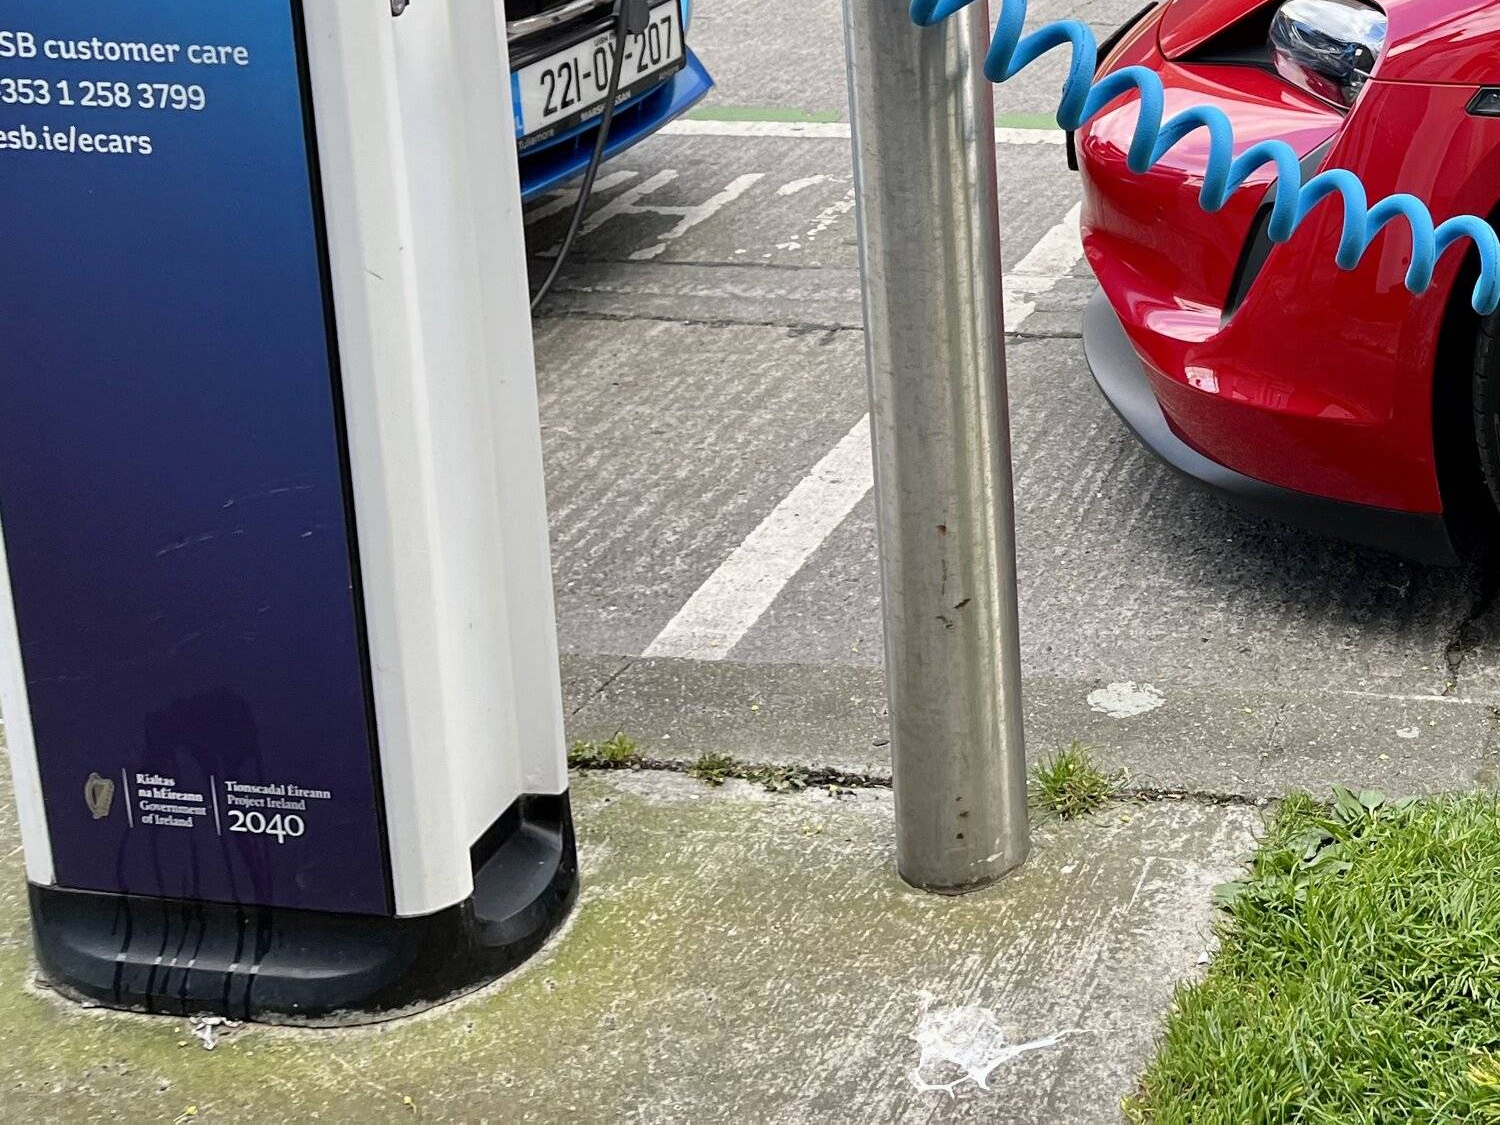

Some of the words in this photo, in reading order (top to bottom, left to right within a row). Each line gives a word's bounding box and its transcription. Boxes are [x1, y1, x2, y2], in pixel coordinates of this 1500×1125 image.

[43, 37, 181, 63] customer
[187, 44, 249, 66] care
[56, 79, 75, 106] 1
[78, 81, 132, 108] 258
[136, 83, 206, 111] 3799
[135, 773, 176, 787] Rialtas
[138, 789, 153, 798] na
[224, 780, 286, 796] Tionscadal
[286, 783, 331, 799] Éireann
[139, 800, 207, 816] Government
[227, 794, 266, 809] Project
[266, 797, 306, 811] Ireland
[141, 813, 154, 824] of
[154, 814, 194, 828] Ireland
[227, 809, 305, 844] 2040
